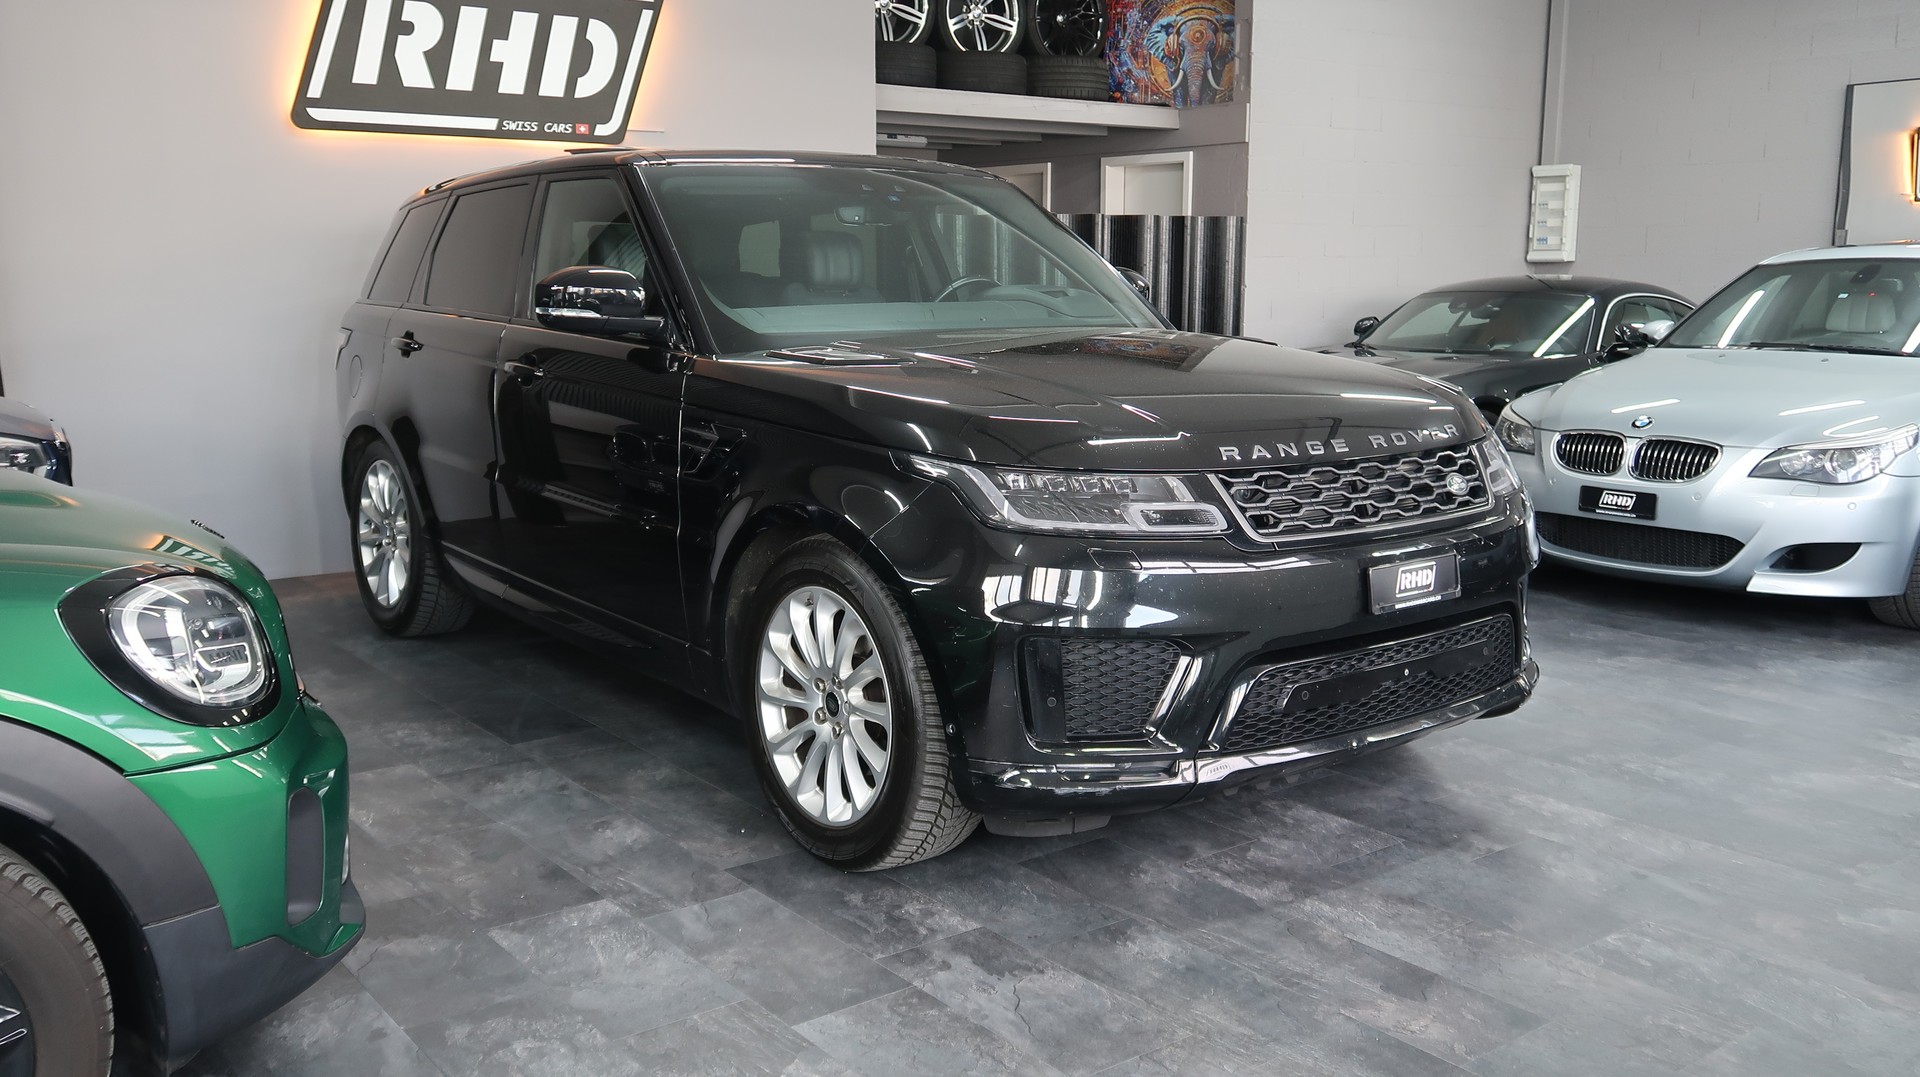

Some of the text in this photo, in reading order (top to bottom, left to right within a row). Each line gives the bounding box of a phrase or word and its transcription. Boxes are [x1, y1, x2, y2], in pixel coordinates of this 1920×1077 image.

[351, 0, 619, 98] RHD
[501, 120, 573, 134] SWISS CARS
[1218, 423, 1459, 461] RANGE ROVER
[1602, 494, 1632, 507] RHD
[1400, 568, 1433, 590] RHD
